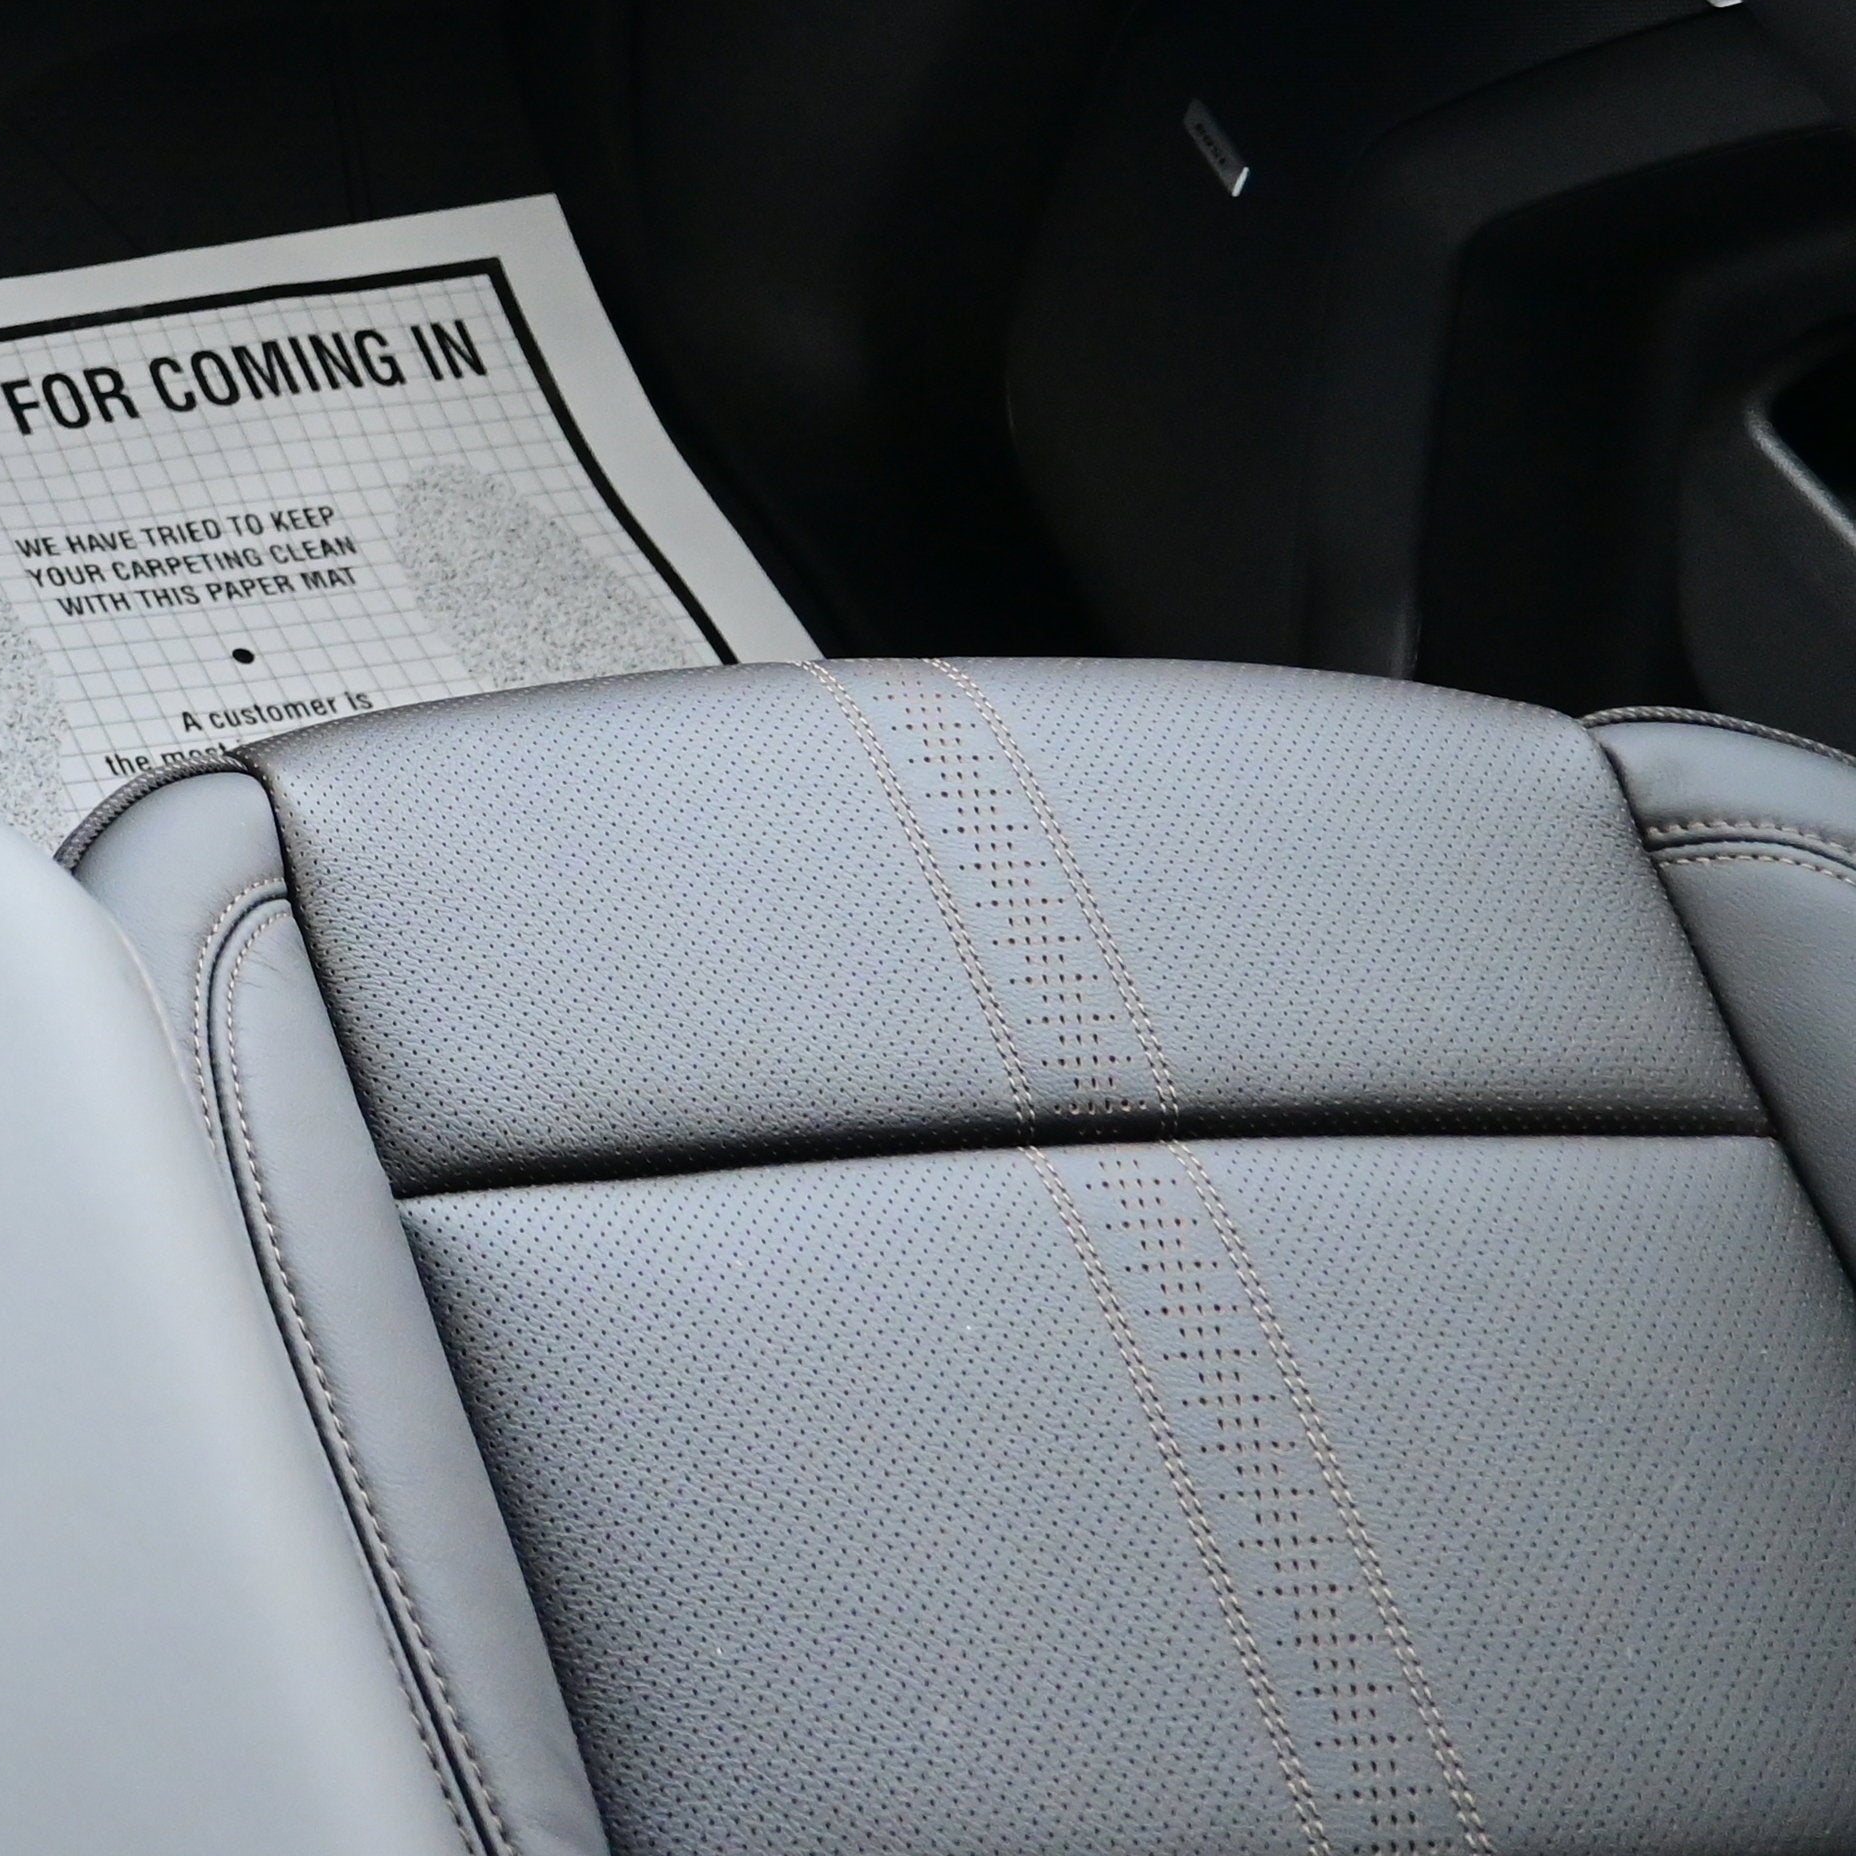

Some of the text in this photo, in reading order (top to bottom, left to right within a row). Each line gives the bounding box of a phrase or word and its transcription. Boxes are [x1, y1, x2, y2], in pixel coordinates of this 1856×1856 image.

[0, 365, 140, 436] FOR
[148, 328, 407, 414] COMING
[409, 319, 488, 381] IN
[15, 505, 336, 559] WE HAVE TRIED TO KEEP
[26, 535, 357, 589] YOUR CARPETING CLEAN
[57, 565, 360, 618] WITH THIS PAPER MAT
[181, 691, 374, 733] A customer is
[105, 742, 230, 776] the most
